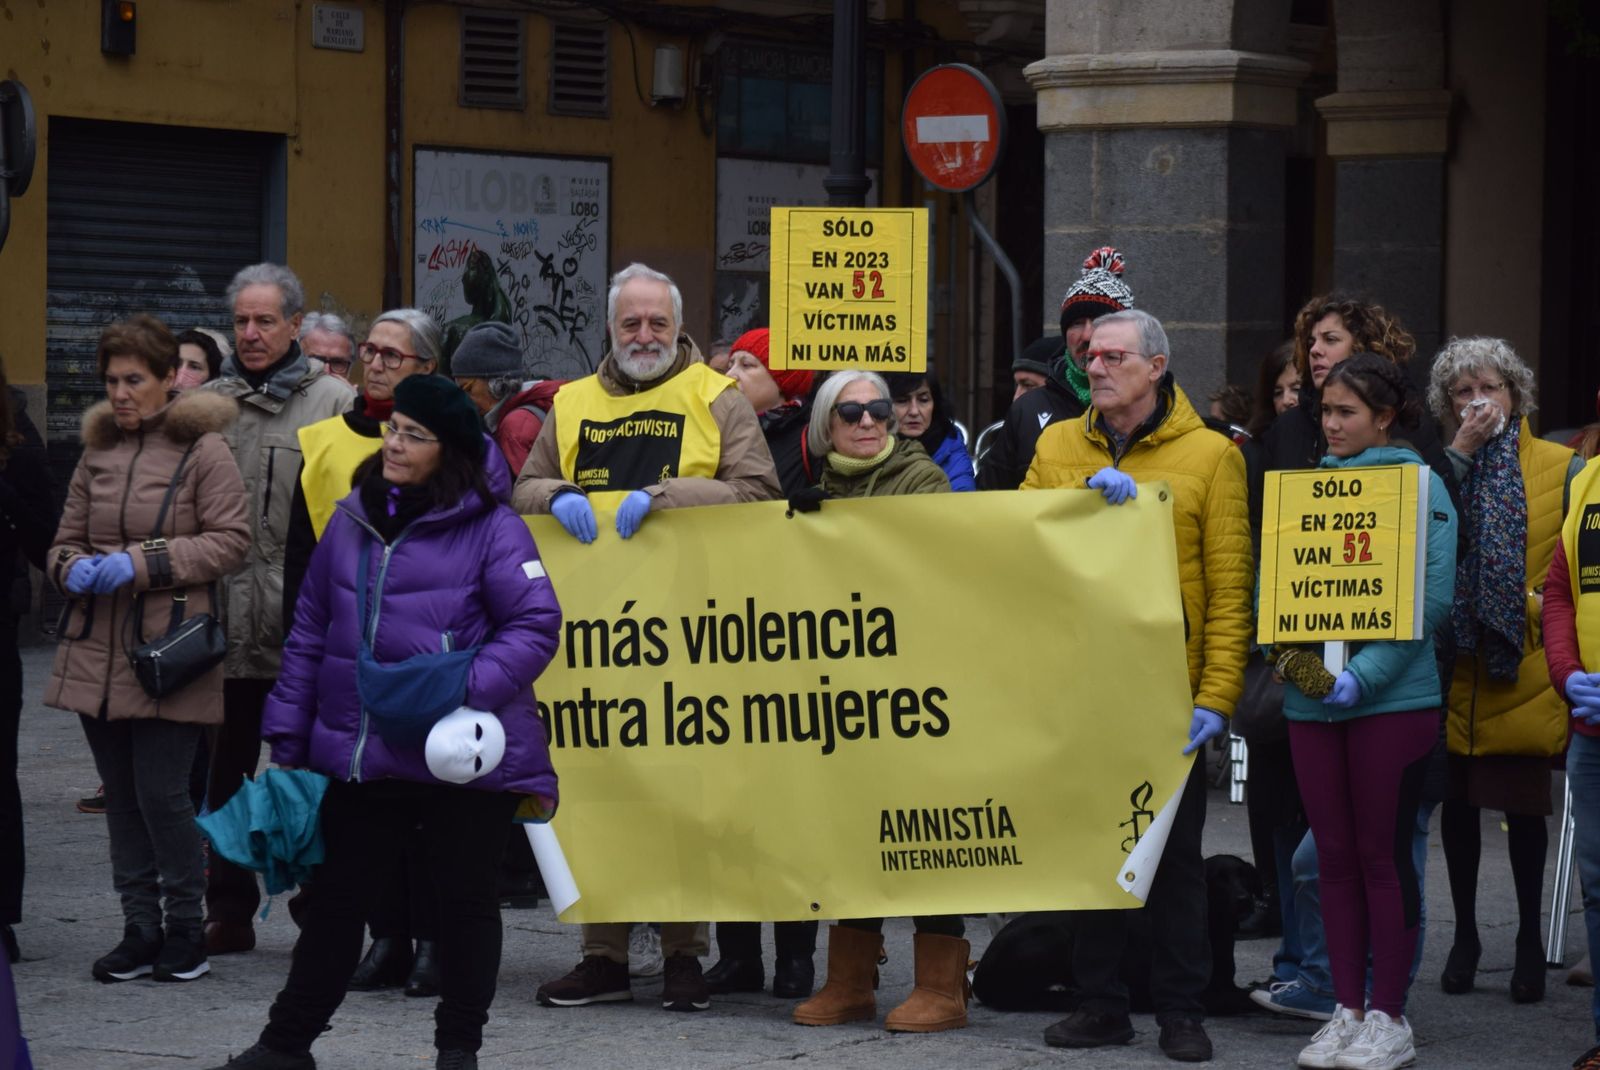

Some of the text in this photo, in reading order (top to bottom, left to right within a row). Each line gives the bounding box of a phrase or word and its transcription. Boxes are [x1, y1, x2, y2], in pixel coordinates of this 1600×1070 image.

[570, 201, 599, 217] LOBO
[823, 217, 874, 237] SÓLO
[812, 251, 889, 268] EN 2023
[805, 270, 885, 299] VAN 52
[803, 310, 896, 331] VÍCTIMAS
[791, 342, 906, 363] NI UNA MÁS
[616, 419, 678, 438] ACTIVISTA
[1312, 476, 1362, 499] SÓLO
[1301, 511, 1377, 532] EN 2023
[1585, 512, 1600, 530] 10
[1293, 531, 1373, 565] VAN 52
[1291, 576, 1383, 598] VÍCTIMAS
[565, 592, 897, 669] más violencia
[1279, 607, 1392, 632] NI UNA MÁS
[663, 681, 730, 746] las
[742, 676, 950, 755] mujeres
[879, 798, 1017, 843] AMNISTÍA
[881, 845, 1022, 872] INTERNACIONAL
